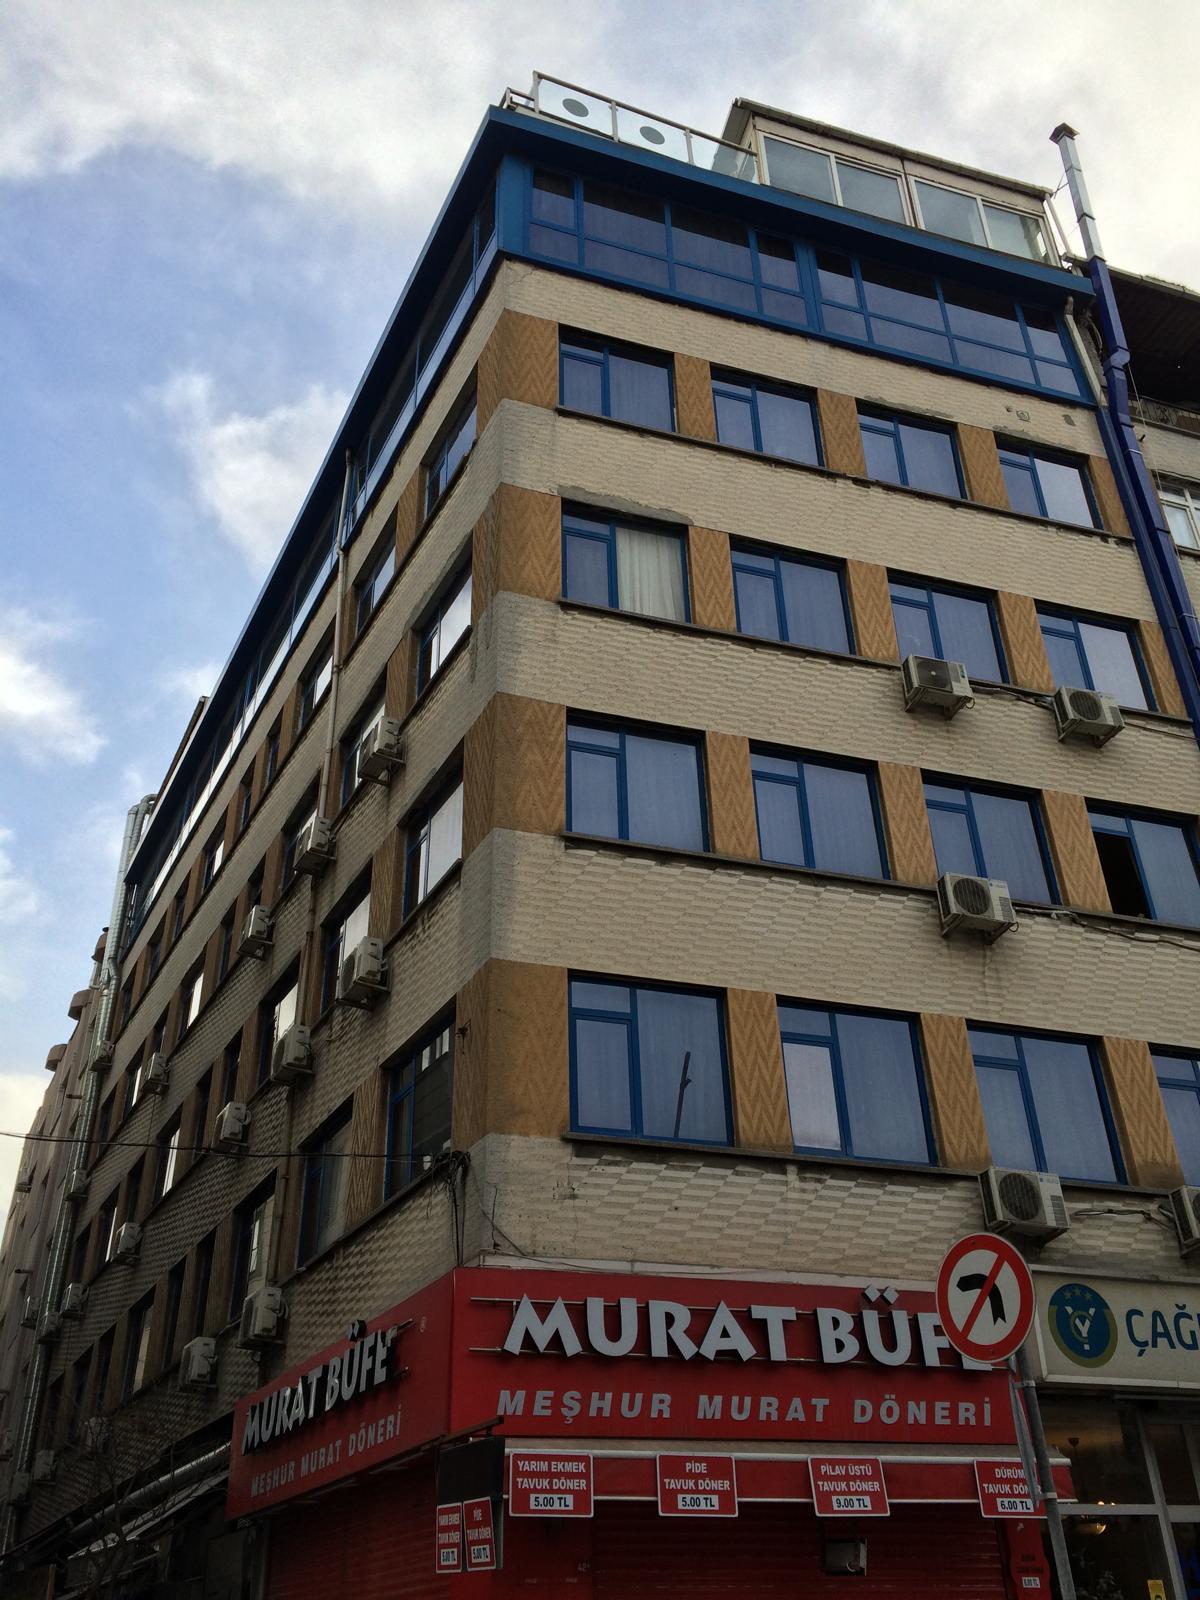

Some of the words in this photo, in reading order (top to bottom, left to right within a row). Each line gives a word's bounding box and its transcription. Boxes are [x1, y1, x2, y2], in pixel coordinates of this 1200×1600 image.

[503, 1293, 797, 1361] MURAT
[816, 1284, 993, 1371] BÜF
[1125, 1303, 1200, 1357] ÇAĞ
[242, 1364, 324, 1455] MURAT
[325, 1319, 398, 1412] BÜFE
[497, 1390, 672, 1424] MEŞHUR
[697, 1395, 830, 1423] MURAT
[853, 1394, 992, 1426] DÖNERİ
[250, 1461, 295, 1498] MEŞHUR
[301, 1439, 343, 1476] MURAT
[349, 1404, 402, 1457] DÖNERİ
[518, 1461, 549, 1472] YARIM
[551, 1462, 586, 1473] EKMEK
[685, 1461, 708, 1474] PİDE
[821, 1464, 846, 1476] PİLAV
[848, 1464, 872, 1476] ÜSTÜ
[517, 1478, 550, 1489] TAVUK
[552, 1477, 587, 1490] DÖNER
[664, 1479, 696, 1490] TAVUK
[698, 1478, 731, 1491] DÖNER
[817, 1481, 848, 1492] TAVUK
[849, 1480, 880, 1492] DÖNER
[983, 1483, 1012, 1494] TAVUK
[1013, 1483, 1042, 1495] DÖR
[534, 1497, 555, 1508] 5.00
[557, 1497, 570, 1508] TL
[681, 1497, 701, 1508] 5.00
[703, 1497, 716, 1508] TL
[835, 1498, 855, 1508] 9.00
[856, 1498, 868, 1508] TL
[1000, 1500, 1018, 1510] 6.00
[1019, 1501, 1031, 1510] TL
